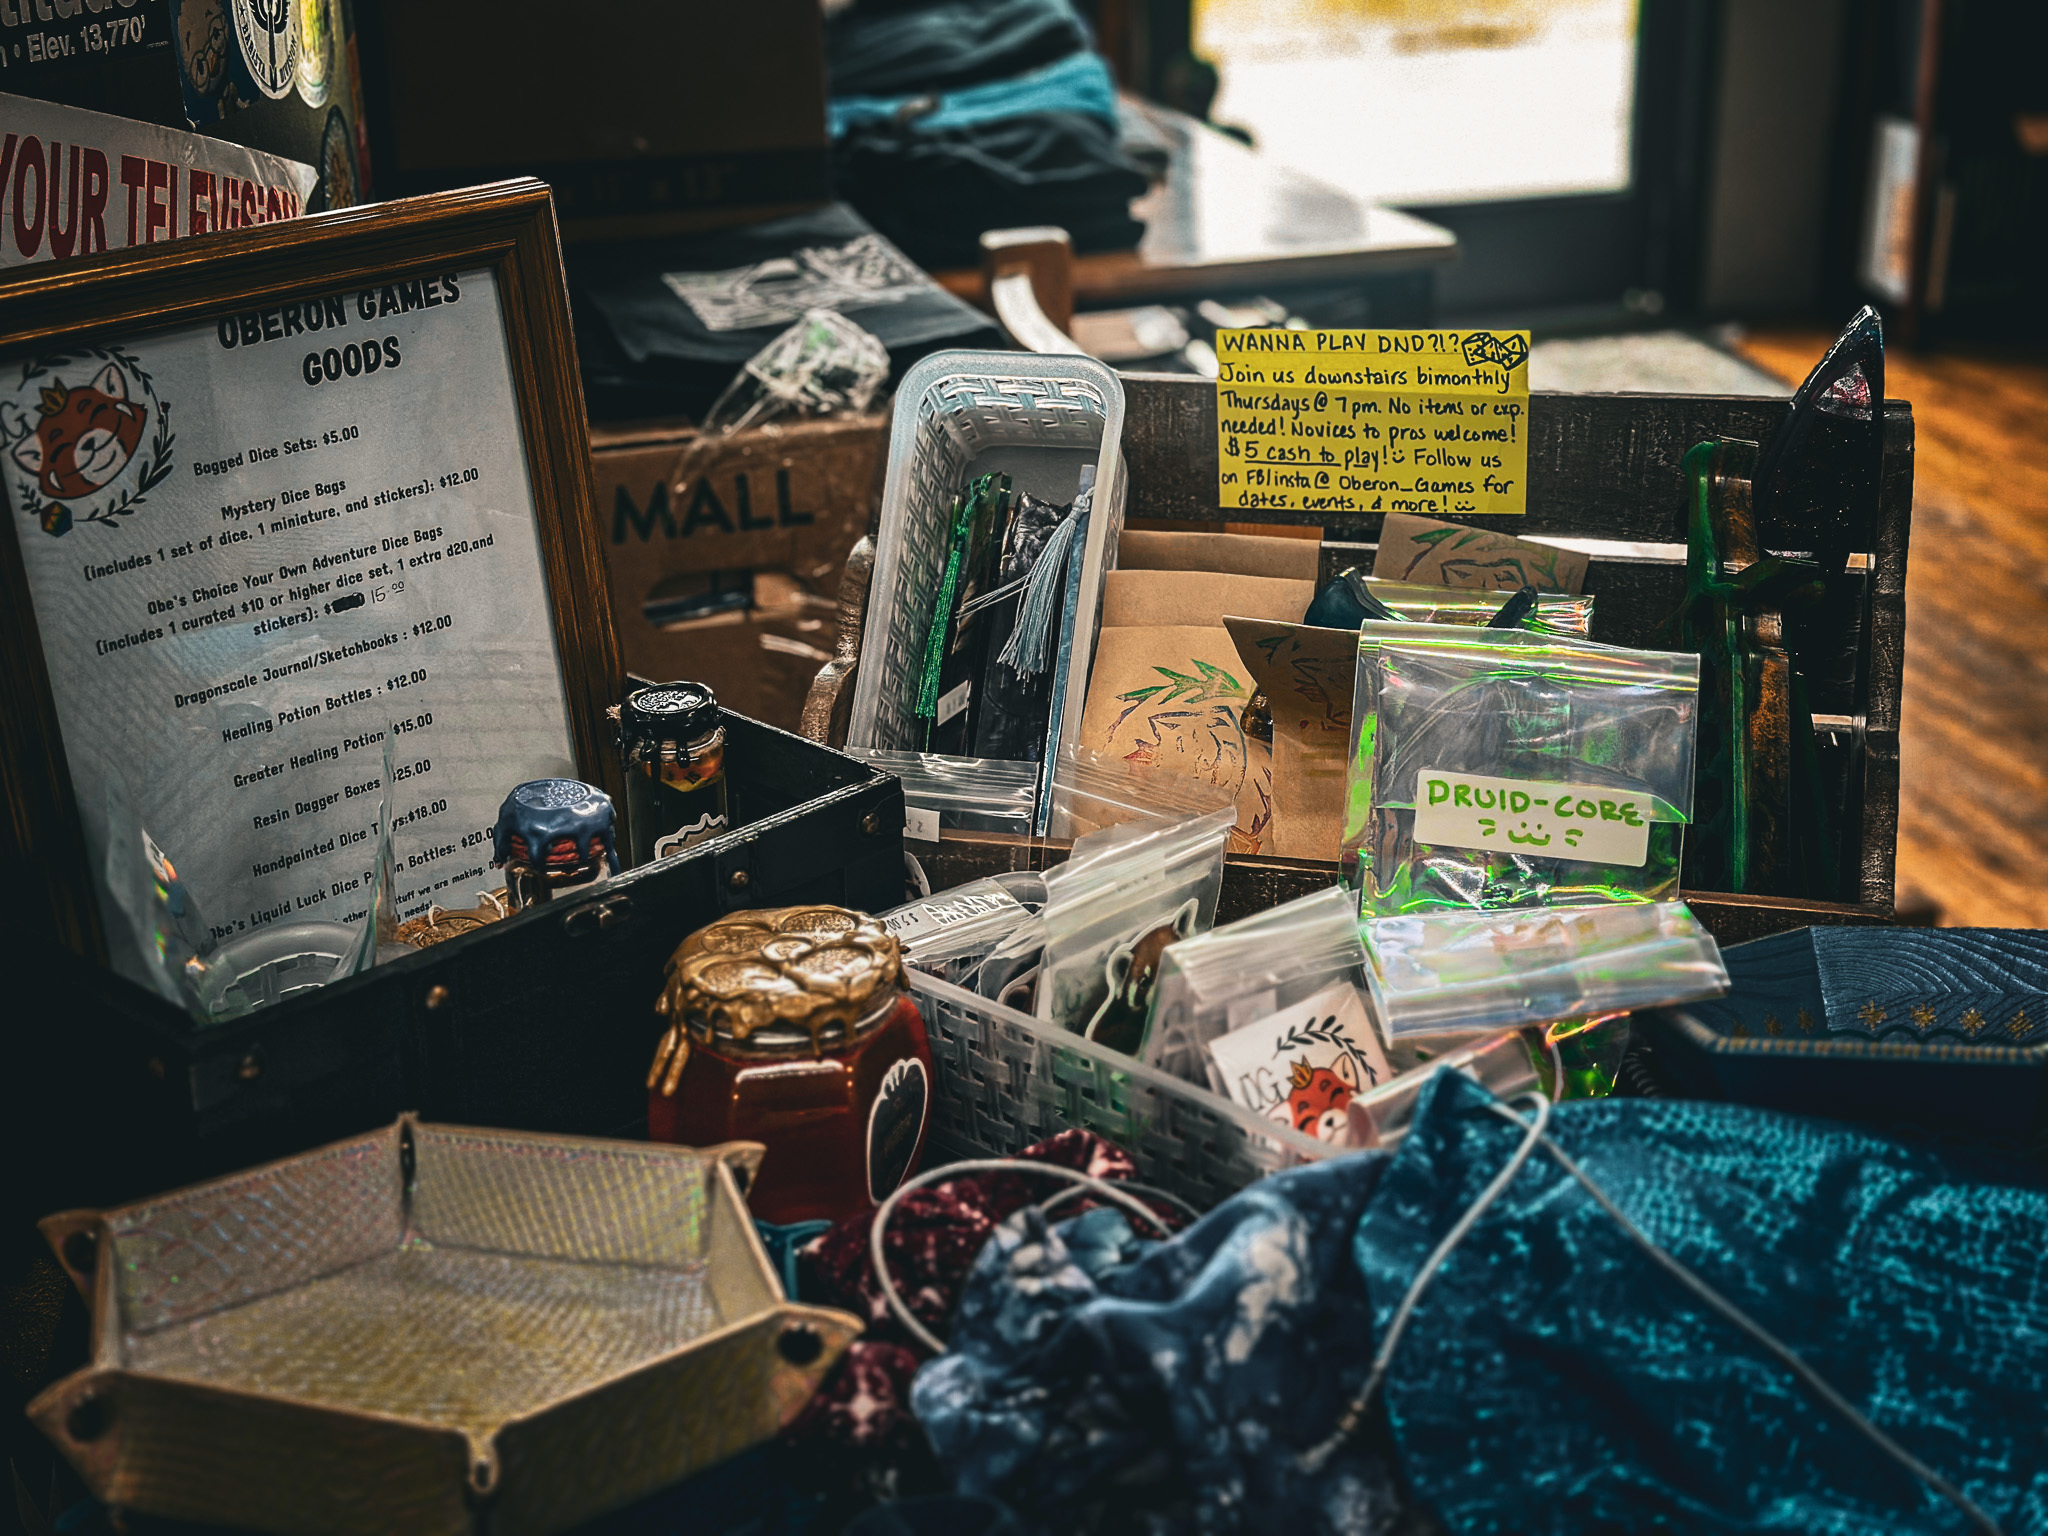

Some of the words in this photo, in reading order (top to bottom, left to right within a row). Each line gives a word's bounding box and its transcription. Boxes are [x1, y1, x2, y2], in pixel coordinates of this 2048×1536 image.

[27, 32, 76, 62] Elev.
[80, 15, 146, 55] 13,770'
[241, 24, 266, 79] BARISTA
[280, 35, 297, 83] DIVISION
[217, 296, 347, 349] OBERON
[357, 273, 461, 321] GAMES
[303, 335, 402, 386] GOODS
[1223, 333, 1306, 352] WANNA
[1317, 333, 1366, 351] PLAY
[1220, 361, 1265, 383] Join
[1273, 371, 1295, 383] us
[1304, 365, 1408, 385] downstairs
[1417, 365, 1510, 394] bimonthly
[1221, 416, 1285, 436] needed!
[1291, 421, 1356, 439] Novices
[1363, 423, 1380, 439] to
[1389, 426, 1427, 449] pros
[1434, 423, 1516, 444] welcome!
[1389, 397, 1411, 414] No
[1419, 398, 1464, 415] items
[1471, 402, 1487, 416] or
[1493, 404, 1525, 422] exp.
[193, 453, 244, 476] Bagged
[249, 448, 278, 463] Dice
[284, 438, 317, 454] Sets:
[323, 426, 359, 445] $5.00
[1267, 446, 1311, 462] cash
[1319, 446, 1335, 463] to
[1345, 445, 1388, 473] play!
[1414, 447, 1471, 468] Follow
[1481, 455, 1502, 468] us
[221, 498, 276, 520] Mystery
[281, 489, 310, 505] Dice
[315, 480, 346, 496] Bags
[611, 468, 815, 545] MALL
[1221, 472, 1238, 486] on
[1339, 475, 1475, 494] Oberon_Games
[1483, 474, 1514, 495] for
[1239, 490, 1295, 508] dates,
[1302, 495, 1363, 511] events,
[1392, 495, 1448, 512] more!
[84, 554, 152, 581] (includes
[157, 548, 165, 561] 1
[171, 541, 194, 558] set
[200, 535, 213, 551] of
[258, 522, 265, 535] 1
[270, 507, 341, 533] miniature,
[345, 496, 368, 513] and
[439, 467, 479, 488] $12.00
[147, 595, 187, 615] Obe's
[192, 581, 239, 603] Choice
[242, 570, 274, 589] Your
[279, 563, 307, 580] Own
[312, 543, 377, 571] Adventure
[381, 535, 410, 552] Dice
[414, 526, 443, 544] Bags
[96, 627, 164, 656] (includes
[168, 621, 177, 634] 1
[182, 605, 236, 631] curated
[241, 597, 265, 614] $10
[270, 594, 284, 607] or
[289, 579, 331, 602] higher
[336, 571, 363, 588] dice
[397, 558, 405, 571] 1
[409, 551, 442, 568] extra
[174, 674, 258, 709] Dragonscale
[262, 632, 399, 682] Journal/Sketchbooks
[412, 614, 452, 637] $12.00
[222, 718, 274, 743] Healing
[278, 704, 321, 725] Potion
[326, 687, 373, 711] Bottles
[387, 668, 427, 691] $12.00
[233, 763, 284, 788] Greater
[290, 745, 339, 771] Healing
[343, 731, 384, 752] Potion
[393, 712, 433, 736] $15.00
[253, 809, 290, 829] Resin
[295, 791, 340, 815] Dagger
[344, 778, 381, 798] Boxes
[1427, 779, 1645, 827] DRUID-CORE
[250, 901, 291, 926] Liquid
[296, 889, 327, 909] Luck
[331, 877, 359, 897] Dice
[408, 844, 456, 868] Bottles:
[461, 827, 495, 849] $20.0
[253, 838, 335, 877] Handpainted
[339, 829, 367, 847] Dice
[418, 886, 431, 896] we
[433, 879, 449, 890] are
